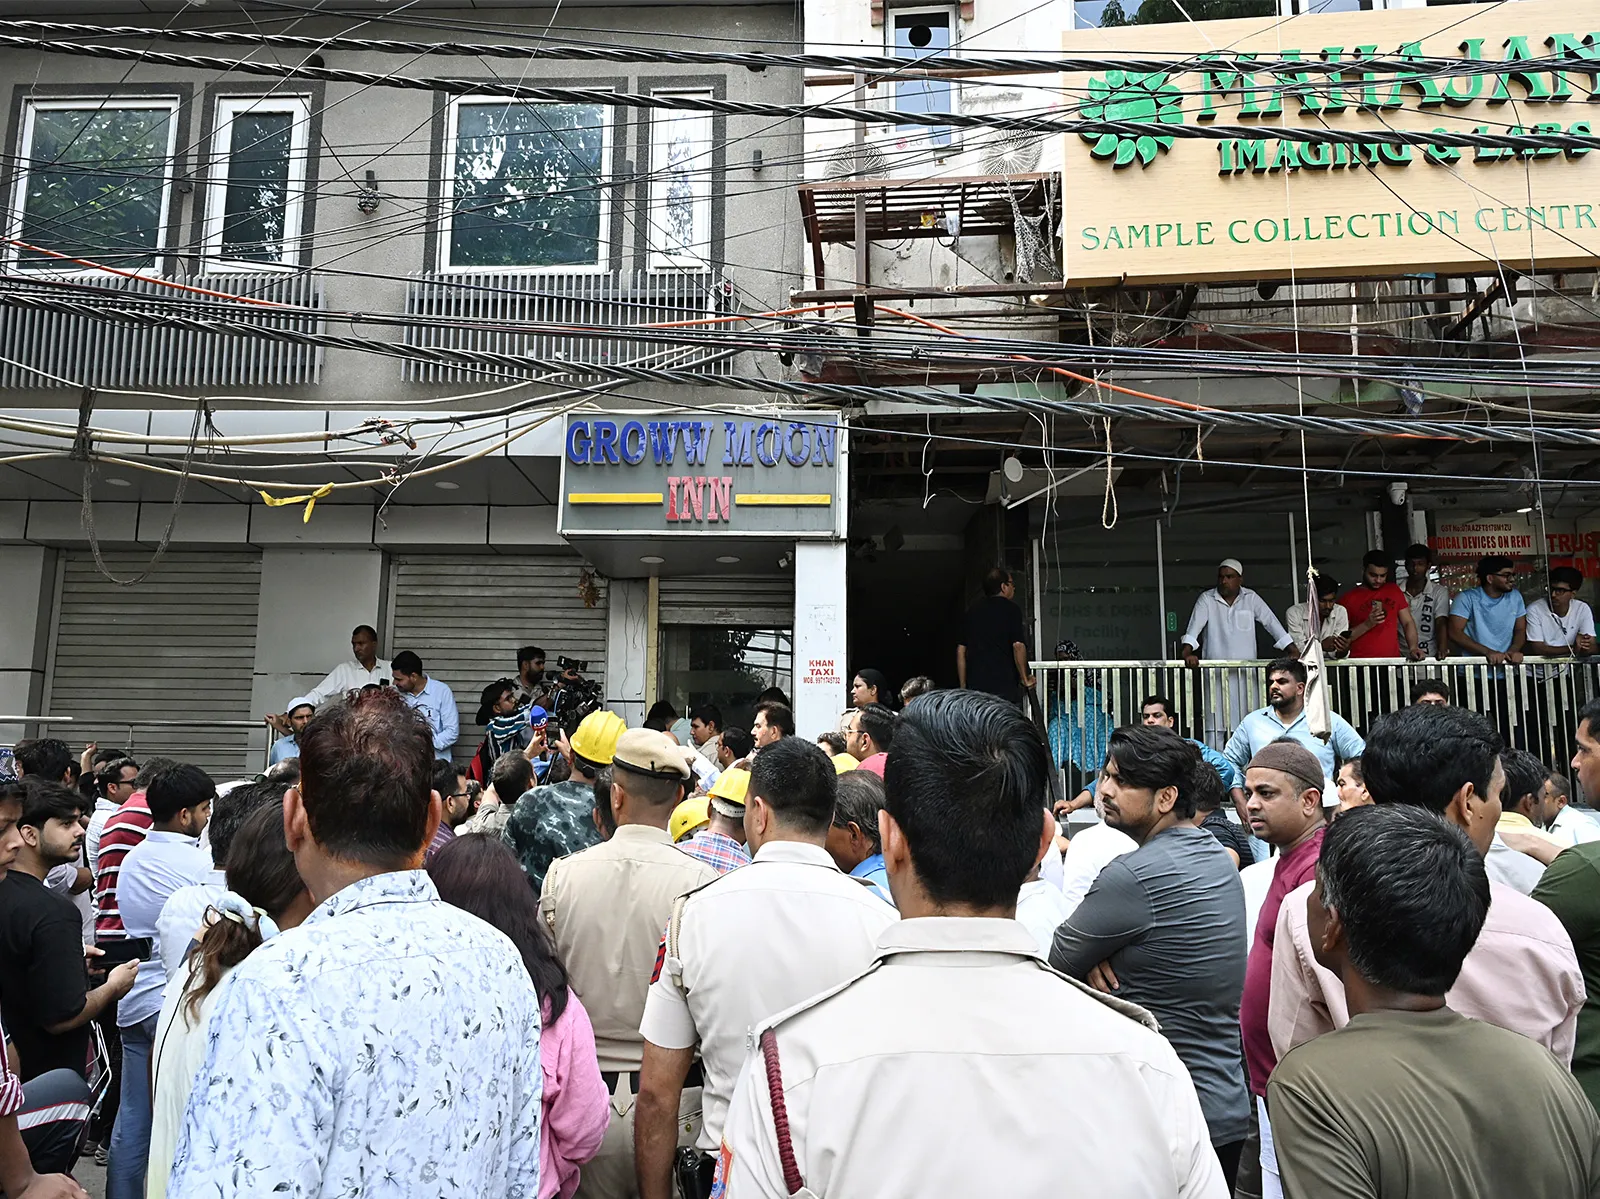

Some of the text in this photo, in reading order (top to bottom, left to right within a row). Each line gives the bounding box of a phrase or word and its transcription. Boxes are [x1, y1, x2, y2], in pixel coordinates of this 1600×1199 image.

[1197, 32, 1600, 119] MAHAJAN
[1217, 129, 1412, 175] IMAGING
[1081, 204, 1600, 250] SAMPLE COLLECTION CENTR
[565, 420, 838, 466] GROWW MOON
[665, 476, 733, 522] INN
[1463, 535, 1496, 549] DEVICES
[1498, 535, 1509, 548] ON
[1510, 535, 1531, 548] RENT
[1420, 595, 1434, 633] AERO
